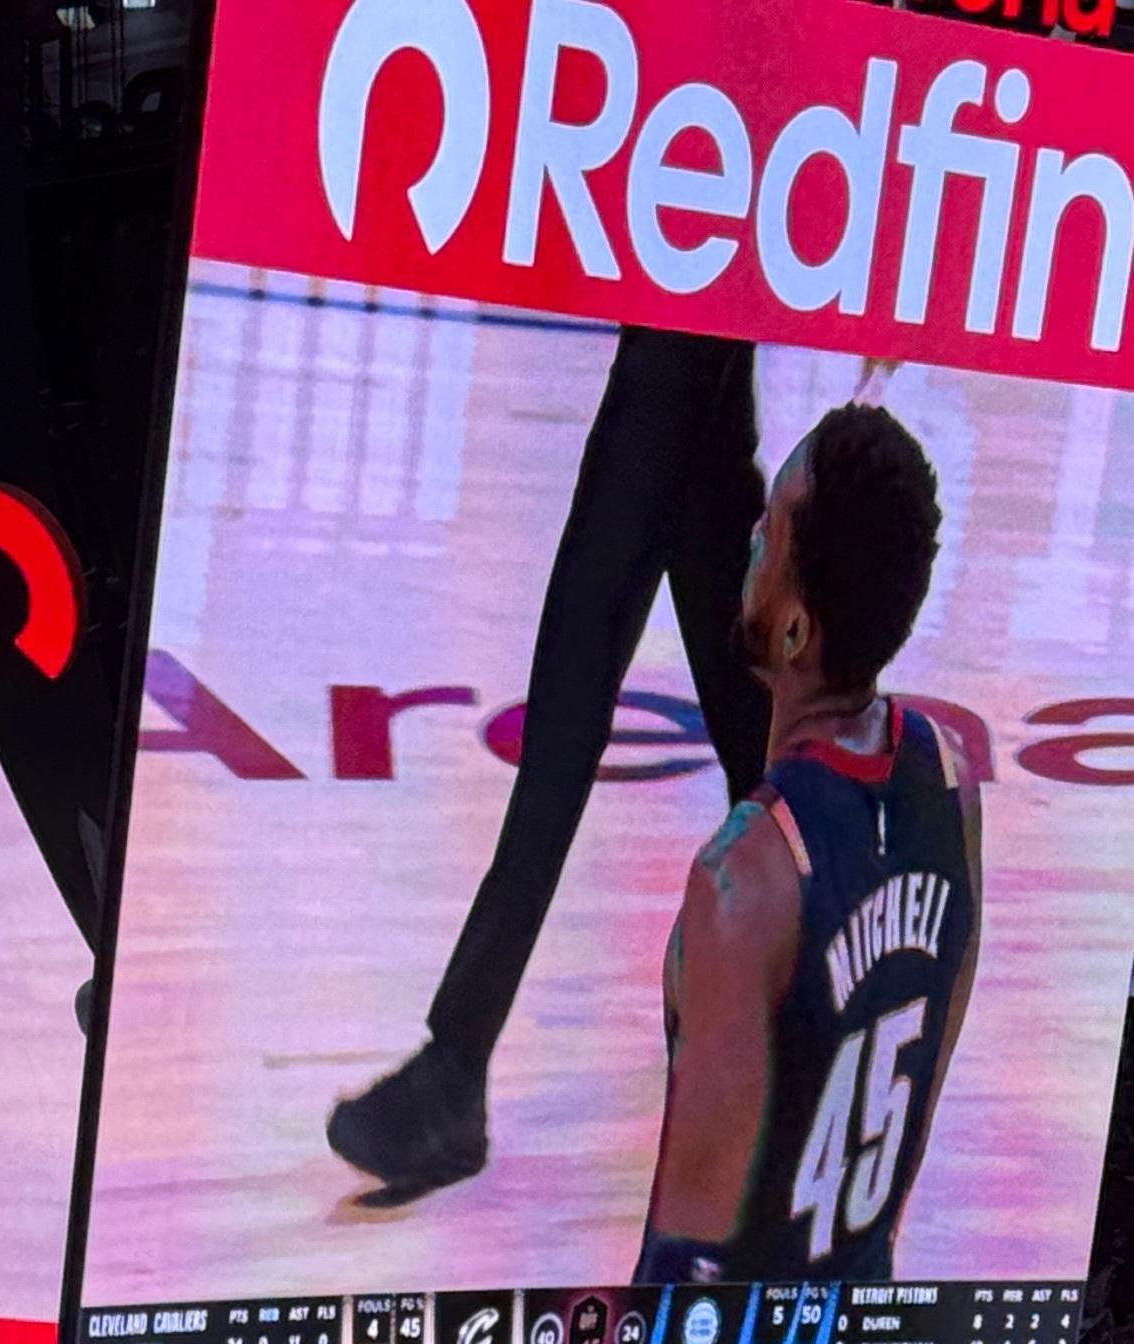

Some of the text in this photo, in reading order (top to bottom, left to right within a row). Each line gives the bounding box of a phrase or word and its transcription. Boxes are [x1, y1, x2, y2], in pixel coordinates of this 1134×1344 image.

[502, 0, 1134, 352] Redfin
[824, 871, 951, 1012] MITCHELL
[791, 997, 928, 1261] 45
[852, 1287, 938, 1305] DETROIT PISTONS
[89, 1308, 208, 1338] CLEVELAND CAVALIERS
[229, 1310, 248, 1324] PTS
[288, 1307, 309, 1321] AST
[773, 1306, 784, 1325] 5
[802, 1305, 821, 1324] 50
[838, 1315, 848, 1332] 0
[863, 1316, 900, 1330] DUREN
[368, 1318, 378, 1338] 4
[400, 1317, 420, 1338] 45
[623, 1325, 640, 1341] 24
